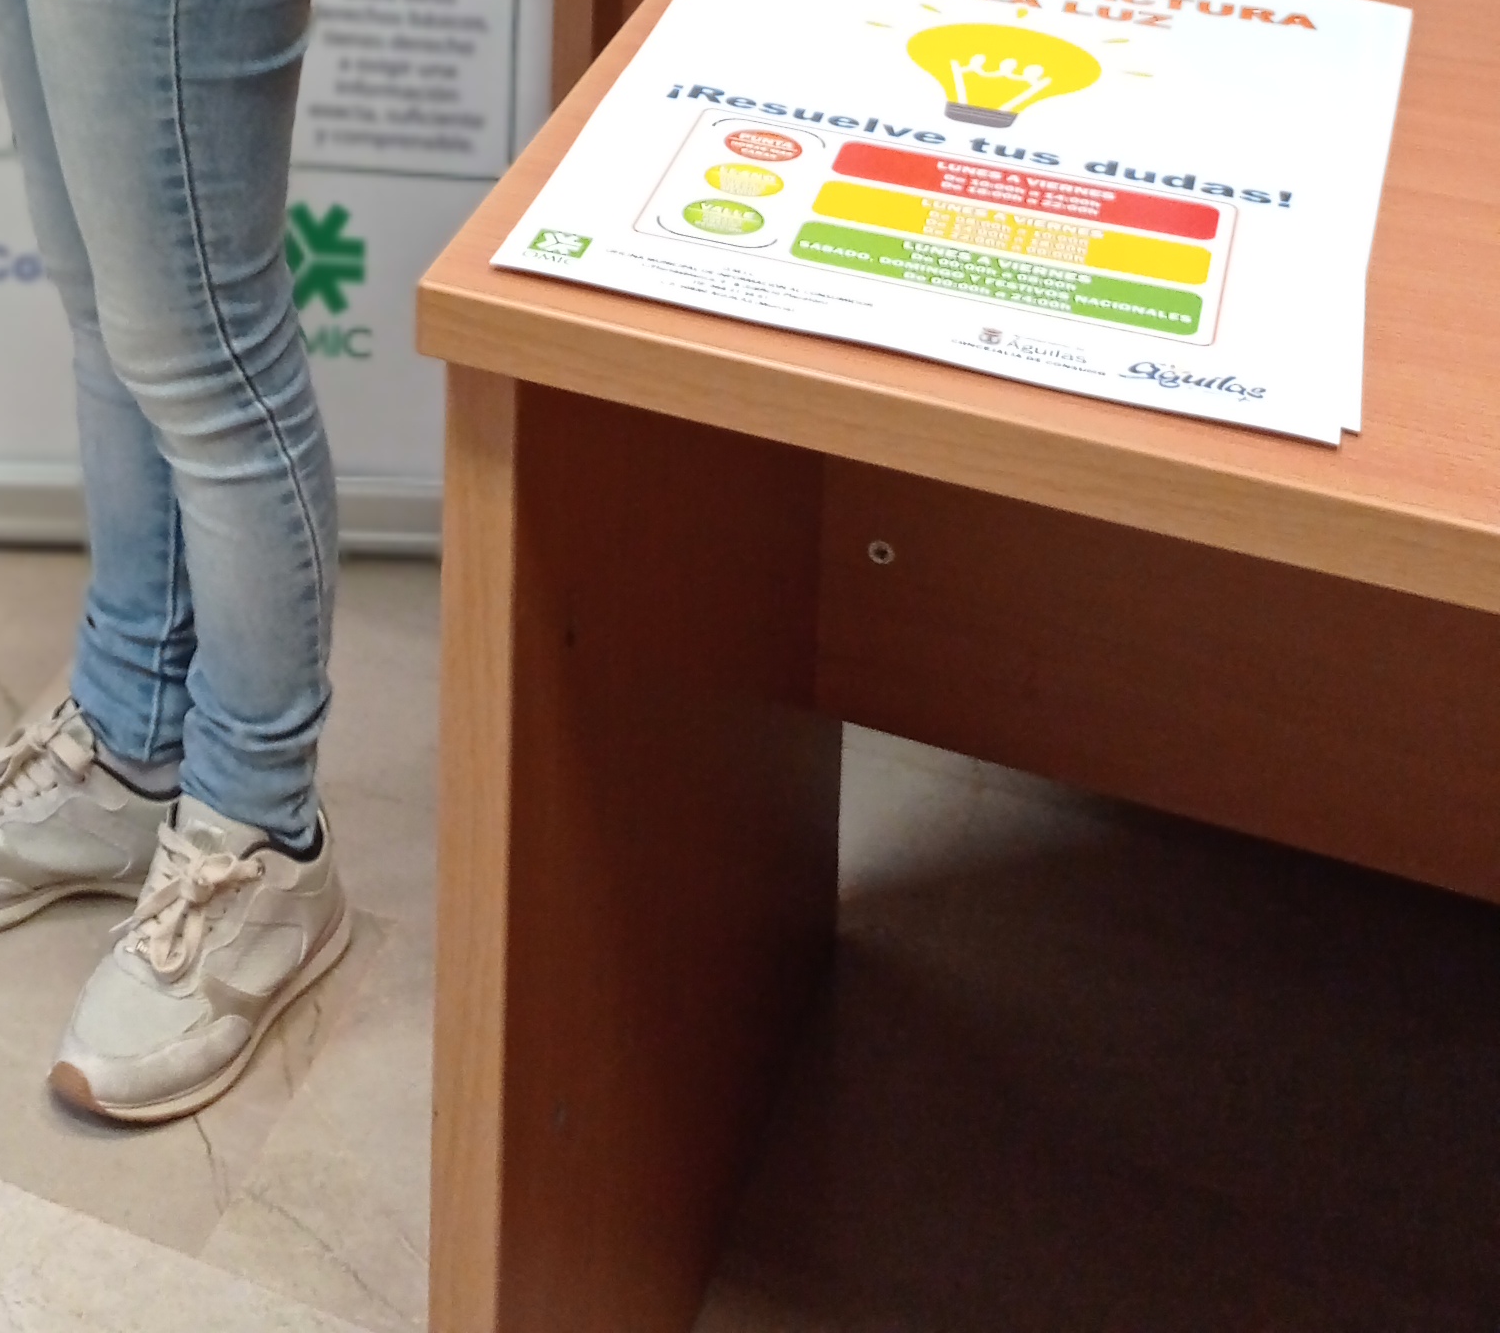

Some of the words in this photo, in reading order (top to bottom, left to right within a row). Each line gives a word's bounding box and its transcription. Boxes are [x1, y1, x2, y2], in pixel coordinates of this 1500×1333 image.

[666, 83, 947, 145] ¡Resuelve
[969, 137, 1061, 167] tus
[1084, 155, 1296, 209] dudas!
[738, 133, 794, 149] PUNTA
[936, 161, 1002, 181] LUNES
[1006, 173, 1022, 183] A
[1026, 177, 1116, 201] VIERNES
[997, 259, 1092, 283] VIERNES
